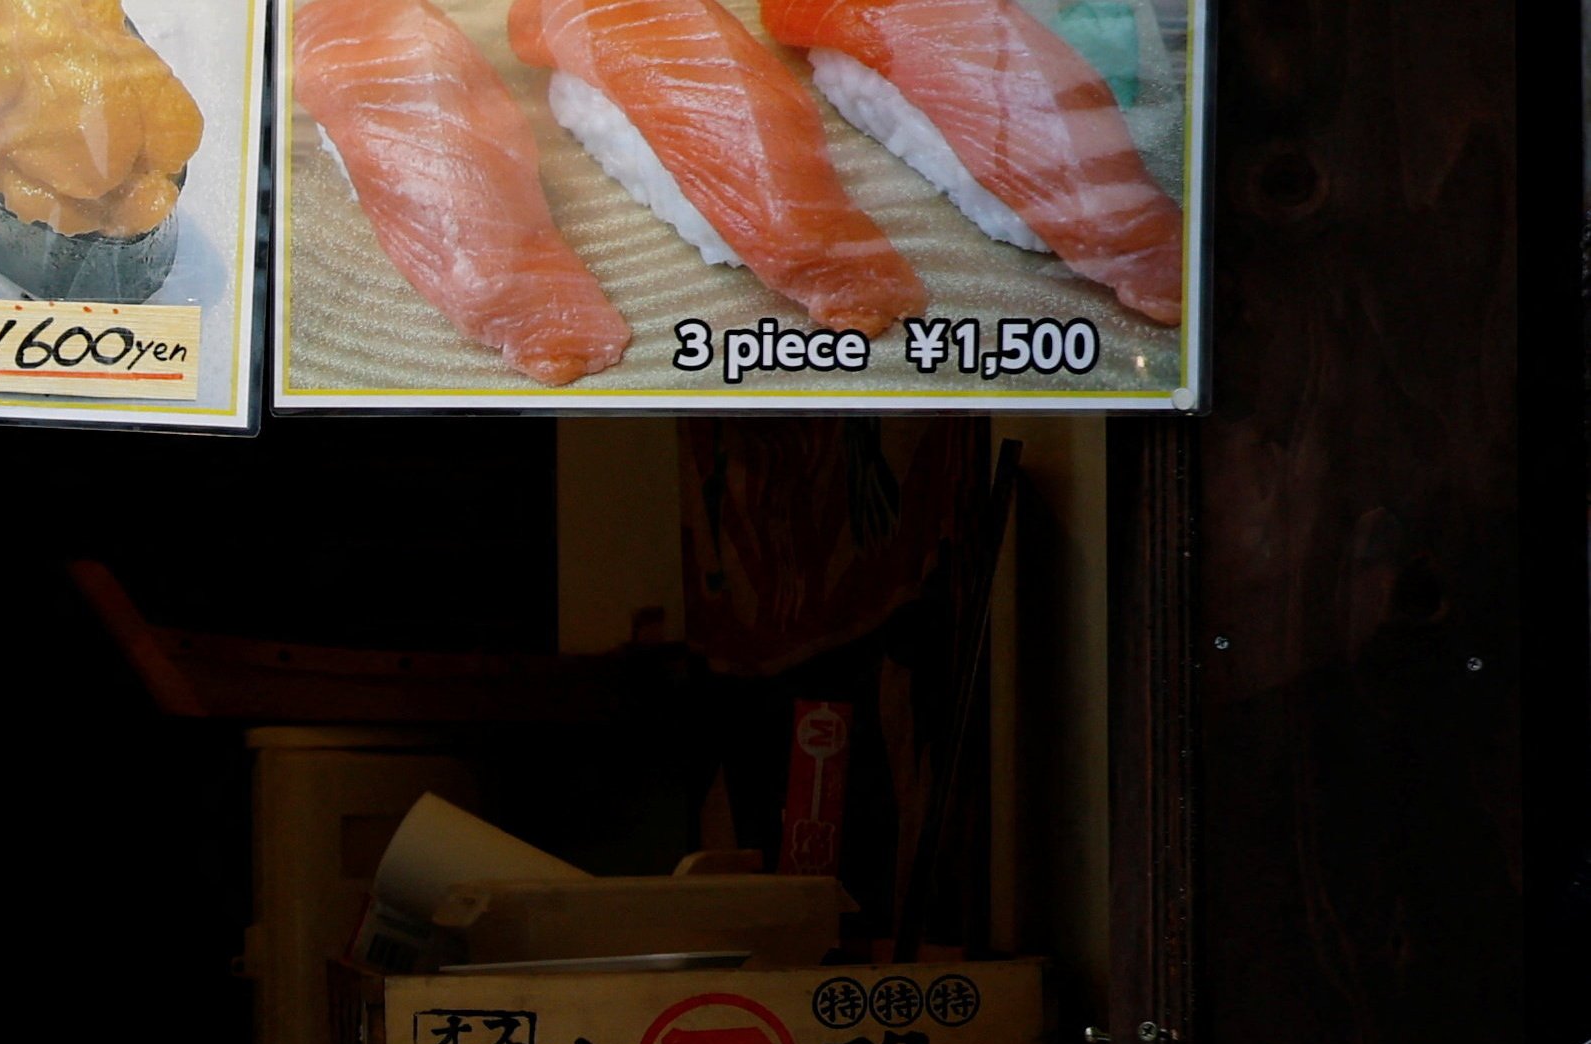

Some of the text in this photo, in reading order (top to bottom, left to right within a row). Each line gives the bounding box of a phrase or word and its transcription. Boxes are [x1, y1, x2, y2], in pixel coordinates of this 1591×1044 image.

[677, 322, 1097, 379] 3 piece ¥1,500
